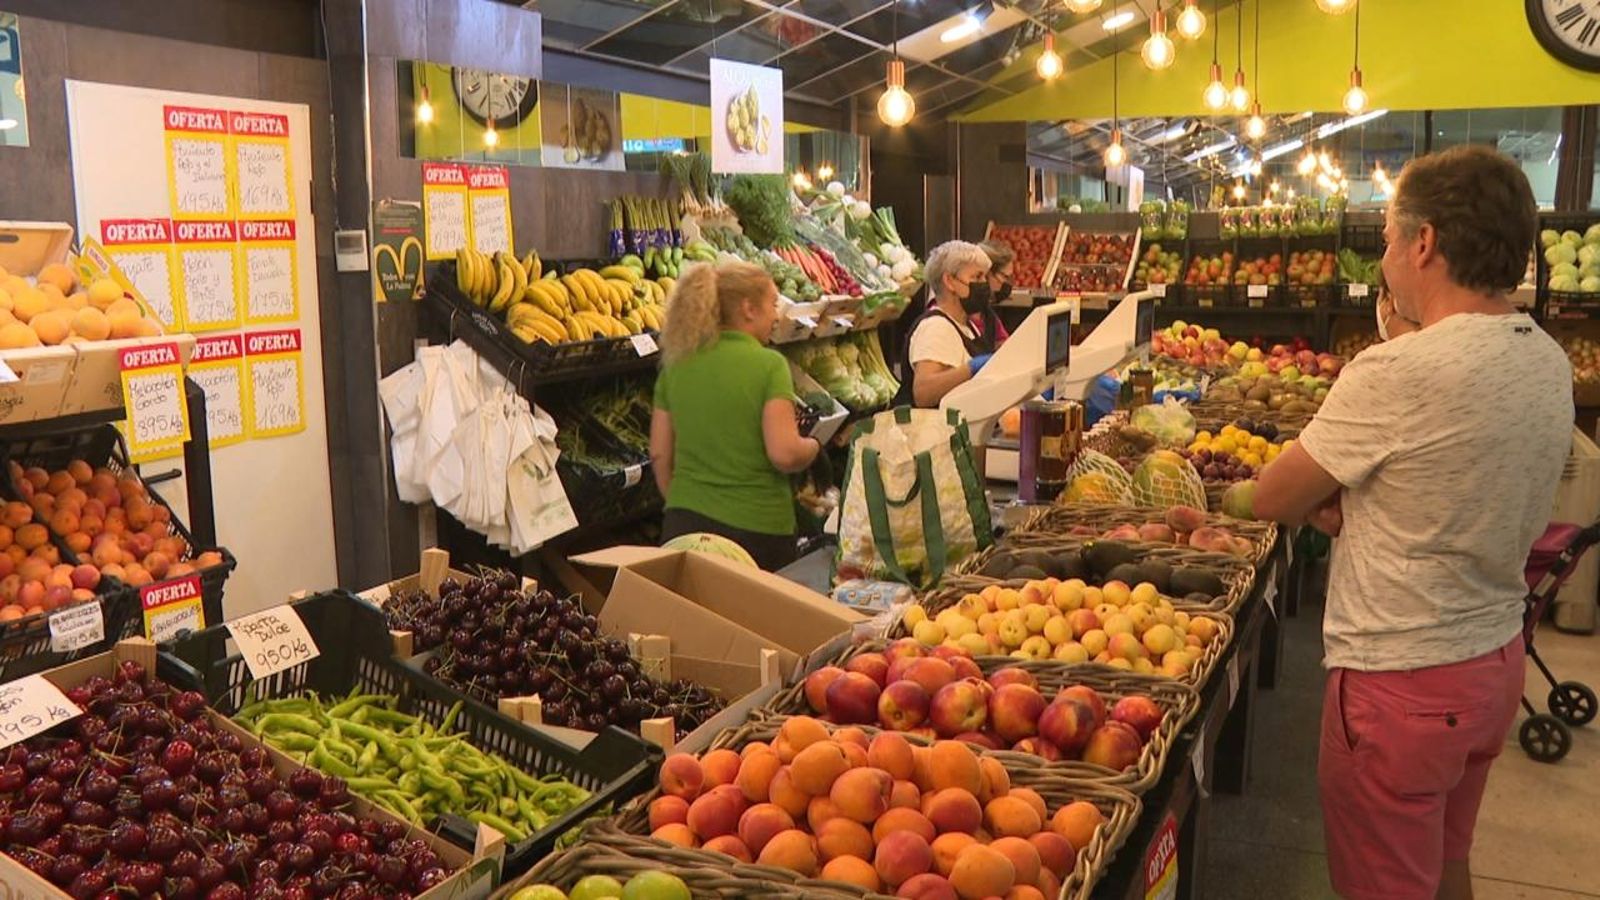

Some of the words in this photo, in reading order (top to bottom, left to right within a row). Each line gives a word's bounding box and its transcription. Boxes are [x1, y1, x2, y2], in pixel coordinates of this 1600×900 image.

[169, 110, 223, 129] OFERTA
[234, 116, 284, 133] OFERTA
[425, 168, 465, 183] OFERTA
[470, 173, 506, 187] OFERTA
[107, 221, 167, 240] OFERTA
[179, 221, 233, 239] OFERTA
[244, 220, 291, 238] OFERTA
[249, 333, 297, 351] OFERTA
[123, 348, 176, 367] OFERTA
[146, 580, 196, 606] OFERTA
[1149, 829, 1176, 885] OFERTA
